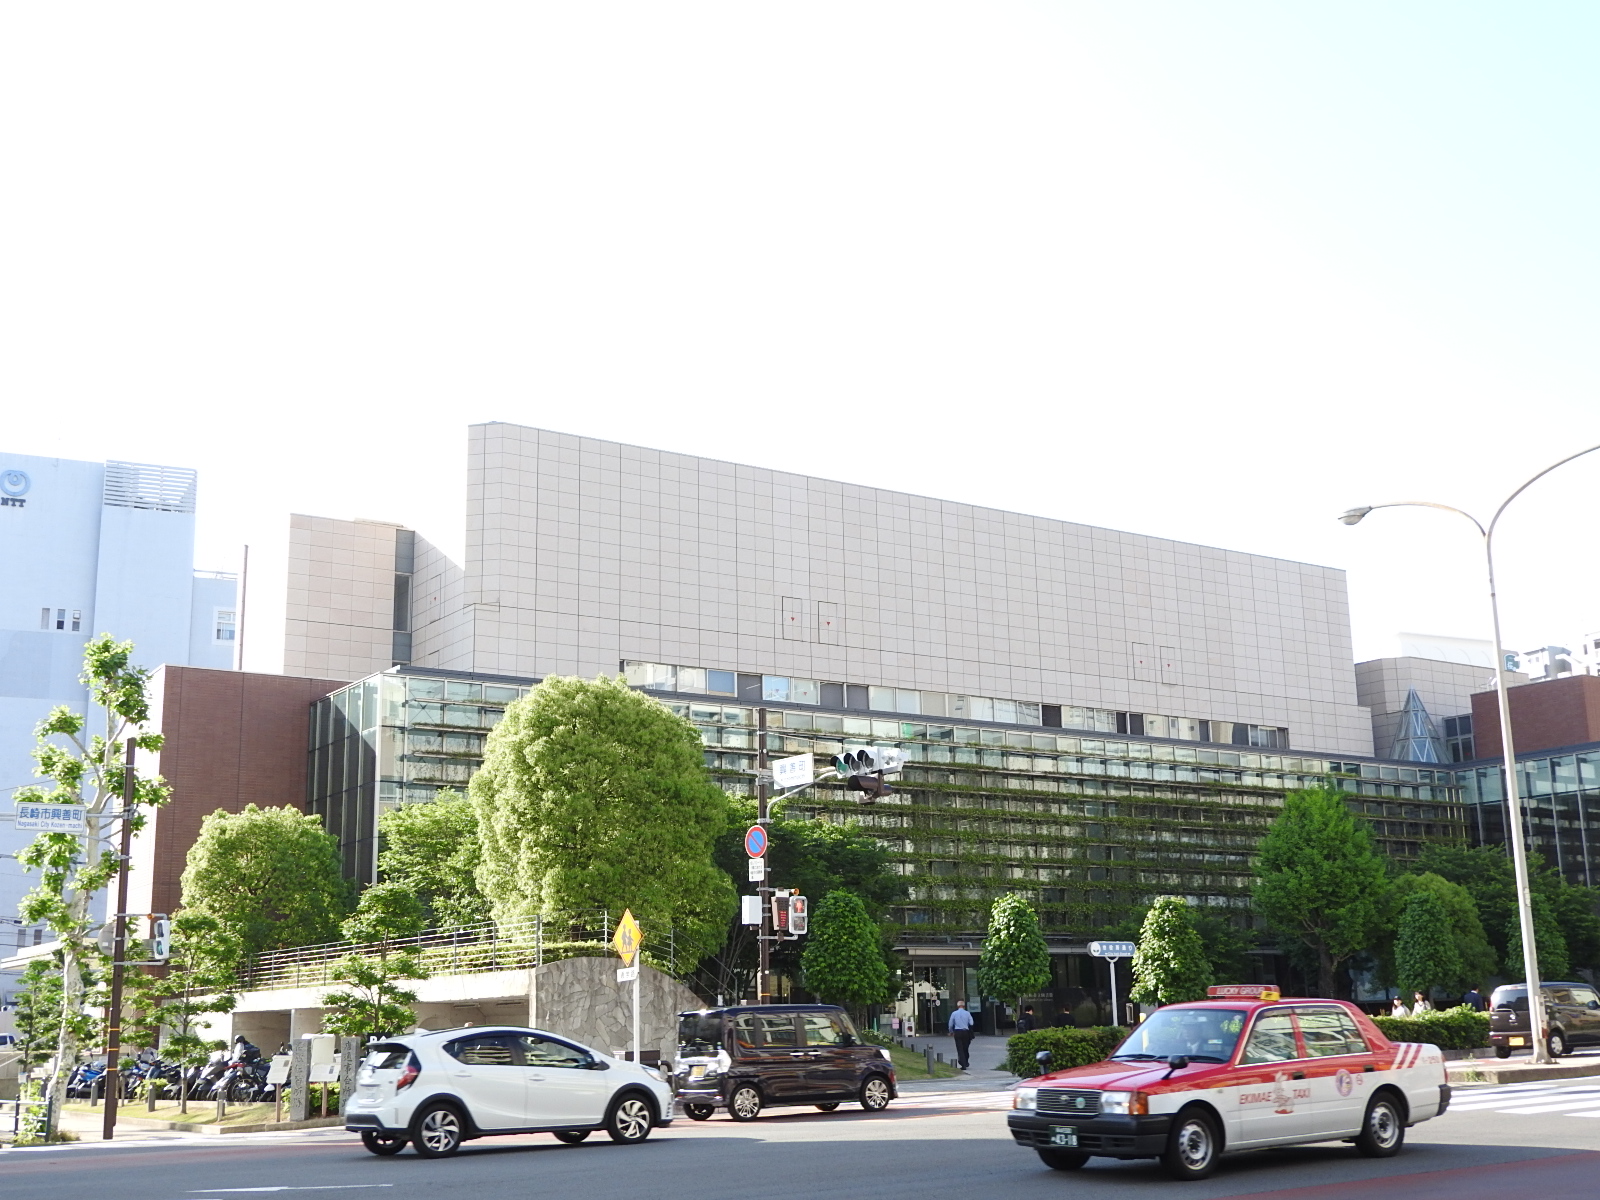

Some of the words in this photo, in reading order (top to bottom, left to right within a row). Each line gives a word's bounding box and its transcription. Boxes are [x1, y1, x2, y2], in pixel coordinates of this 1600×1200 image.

[0, 497, 26, 508] NTT
[20, 807, 82, 821] 長崎市興善町
[18, 820, 40, 828] Nagasaki
[1216, 987, 1238, 995] LUCKY
[1240, 987, 1265, 995] GROUP
[1239, 1092, 1272, 1105] EKIMAE
[1292, 1089, 1311, 1100] TAXI
[1055, 1134, 1078, 1146] 43-18
